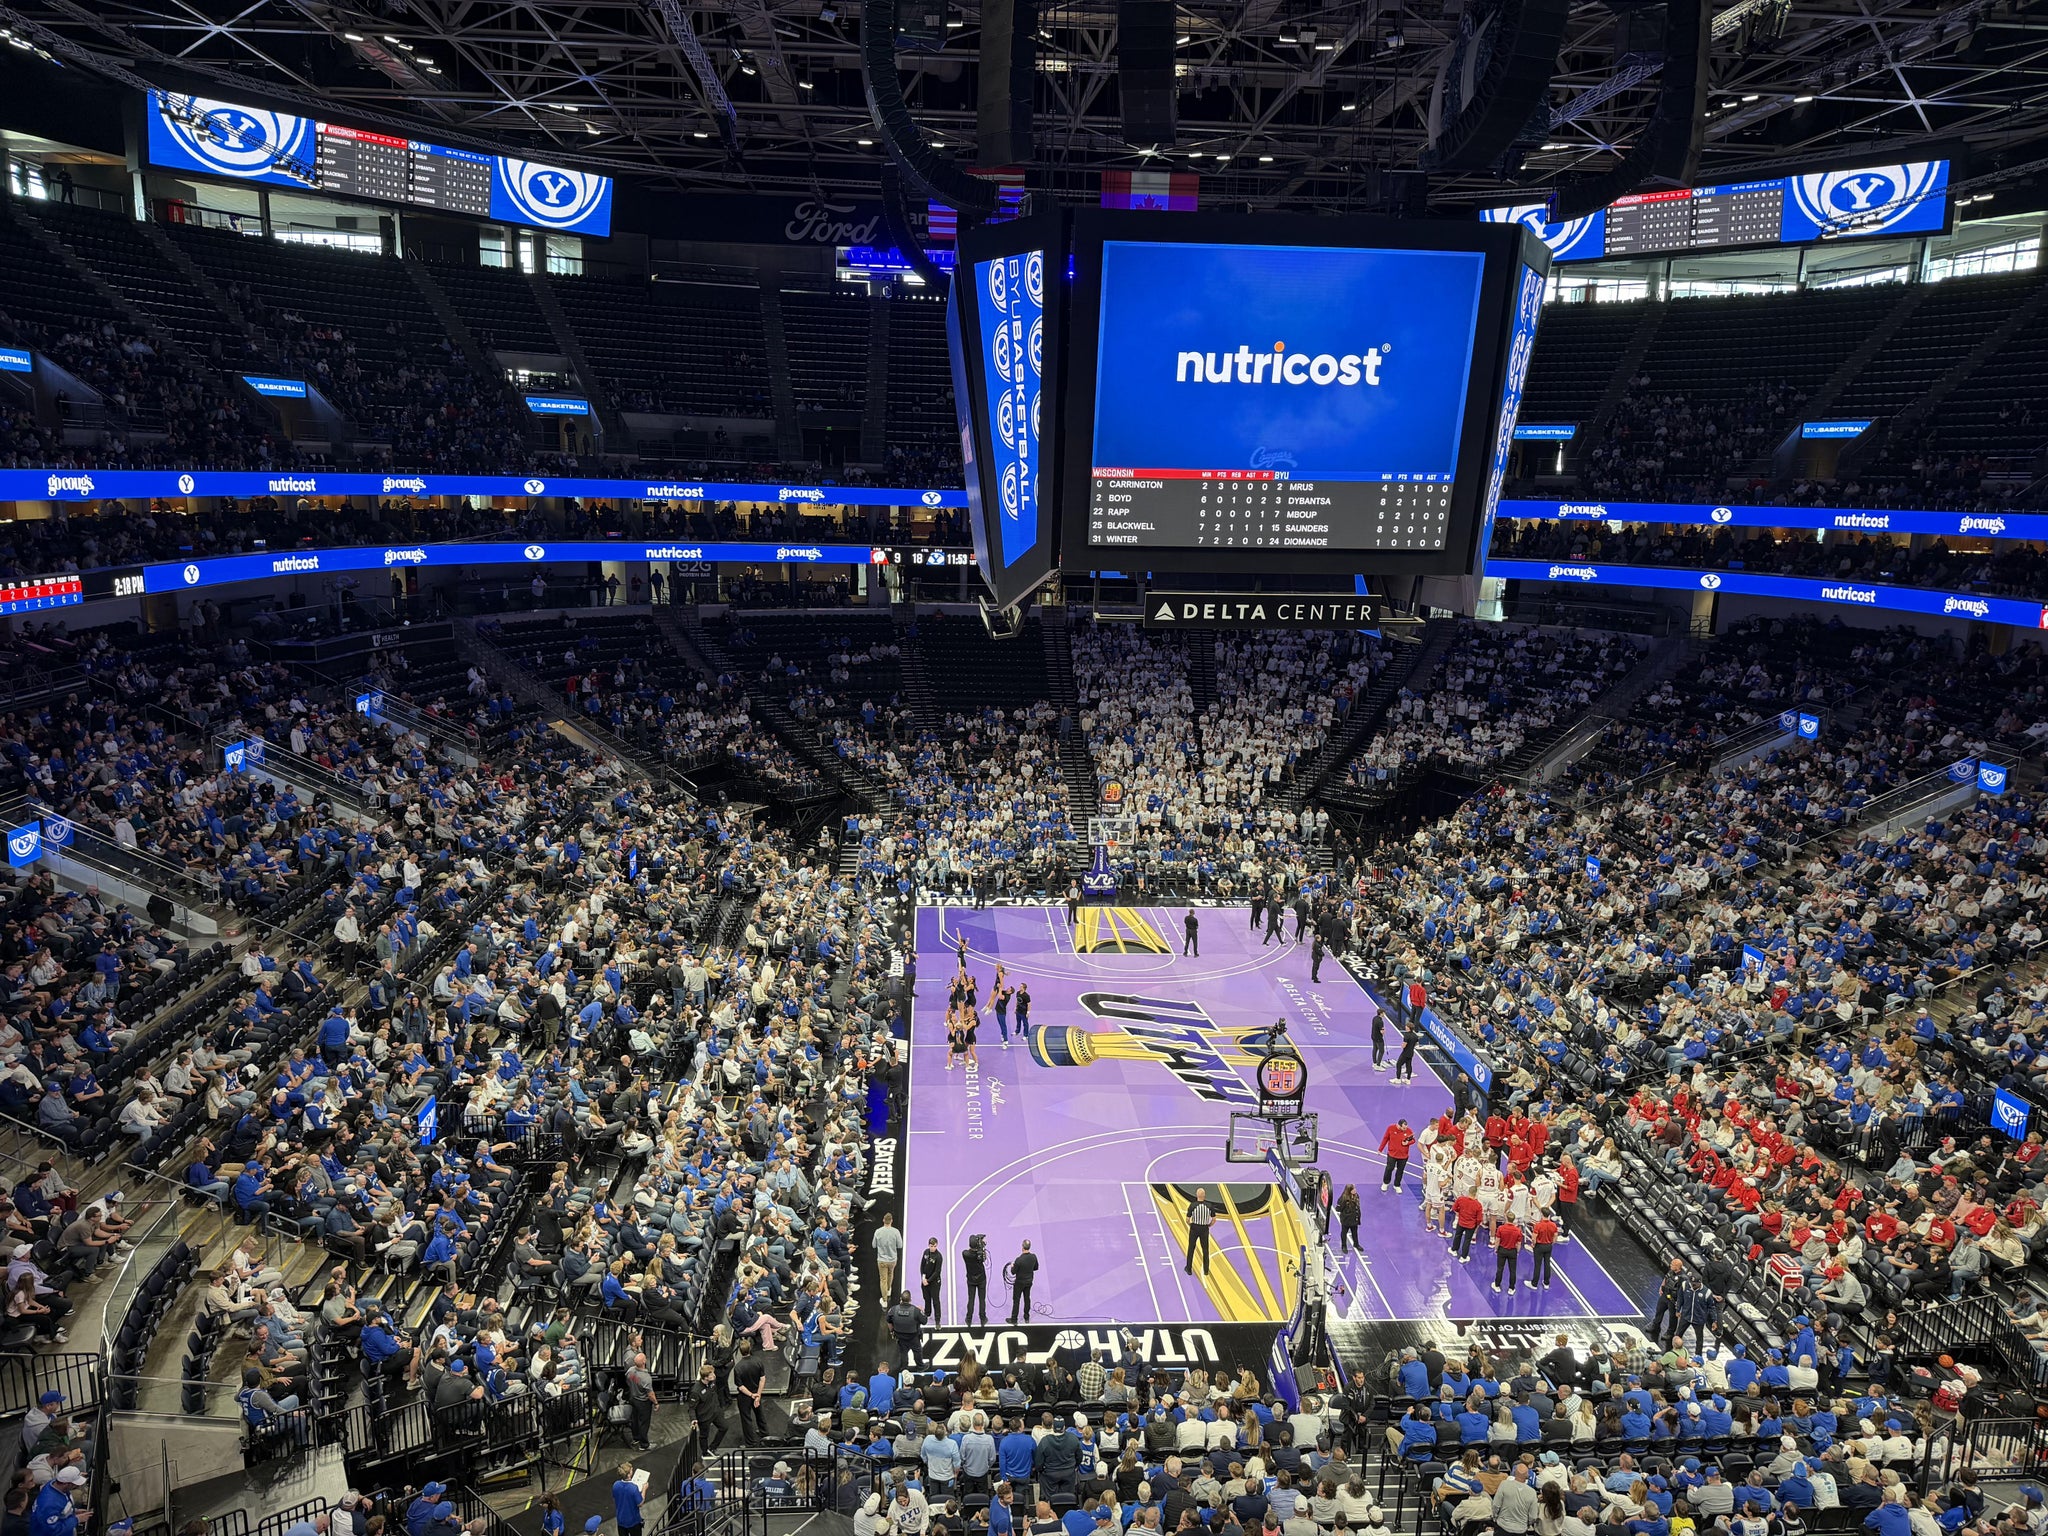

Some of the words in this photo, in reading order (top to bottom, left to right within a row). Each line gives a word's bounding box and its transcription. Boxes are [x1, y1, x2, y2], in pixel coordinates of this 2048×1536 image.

[537, 174, 569, 204] Y
[1841, 178, 1885, 209] Y
[785, 202, 880, 244] Ford
[1177, 341, 1382, 386] nutricost
[1250, 446, 1298, 469] Cougars
[1092, 469, 1134, 478] WISCONSIN
[269, 476, 316, 492] nutricost
[647, 486, 703, 498] nutricost
[1835, 513, 1889, 528] nutricost
[646, 547, 702, 559] nutricost
[894, 553, 900, 563] 9
[912, 553, 923, 563] 18
[947, 554, 967, 565] 11:53
[273, 556, 319, 572] nutricost
[676, 560, 711, 572] G2G
[115, 578, 130, 596] 2:18
[132, 576, 144, 593] PM
[1822, 587, 1875, 602] nutricost
[1183, 604, 1266, 620] DELTA
[1277, 604, 1371, 620] CENTER
[1283, 983, 1302, 1008] DELTA
[1300, 1006, 1330, 1037] CENTER
[1430, 1020, 1456, 1053] nutricost
[1078, 992, 1264, 1110] UTAH
[967, 1100, 983, 1140] CENTER
[868, 1138, 897, 1195] SEATGEEK
[1484, 1178, 1494, 1186] 23
[1088, 1329, 1219, 1362] UTAH
[900, 1507, 920, 1523] BYU
